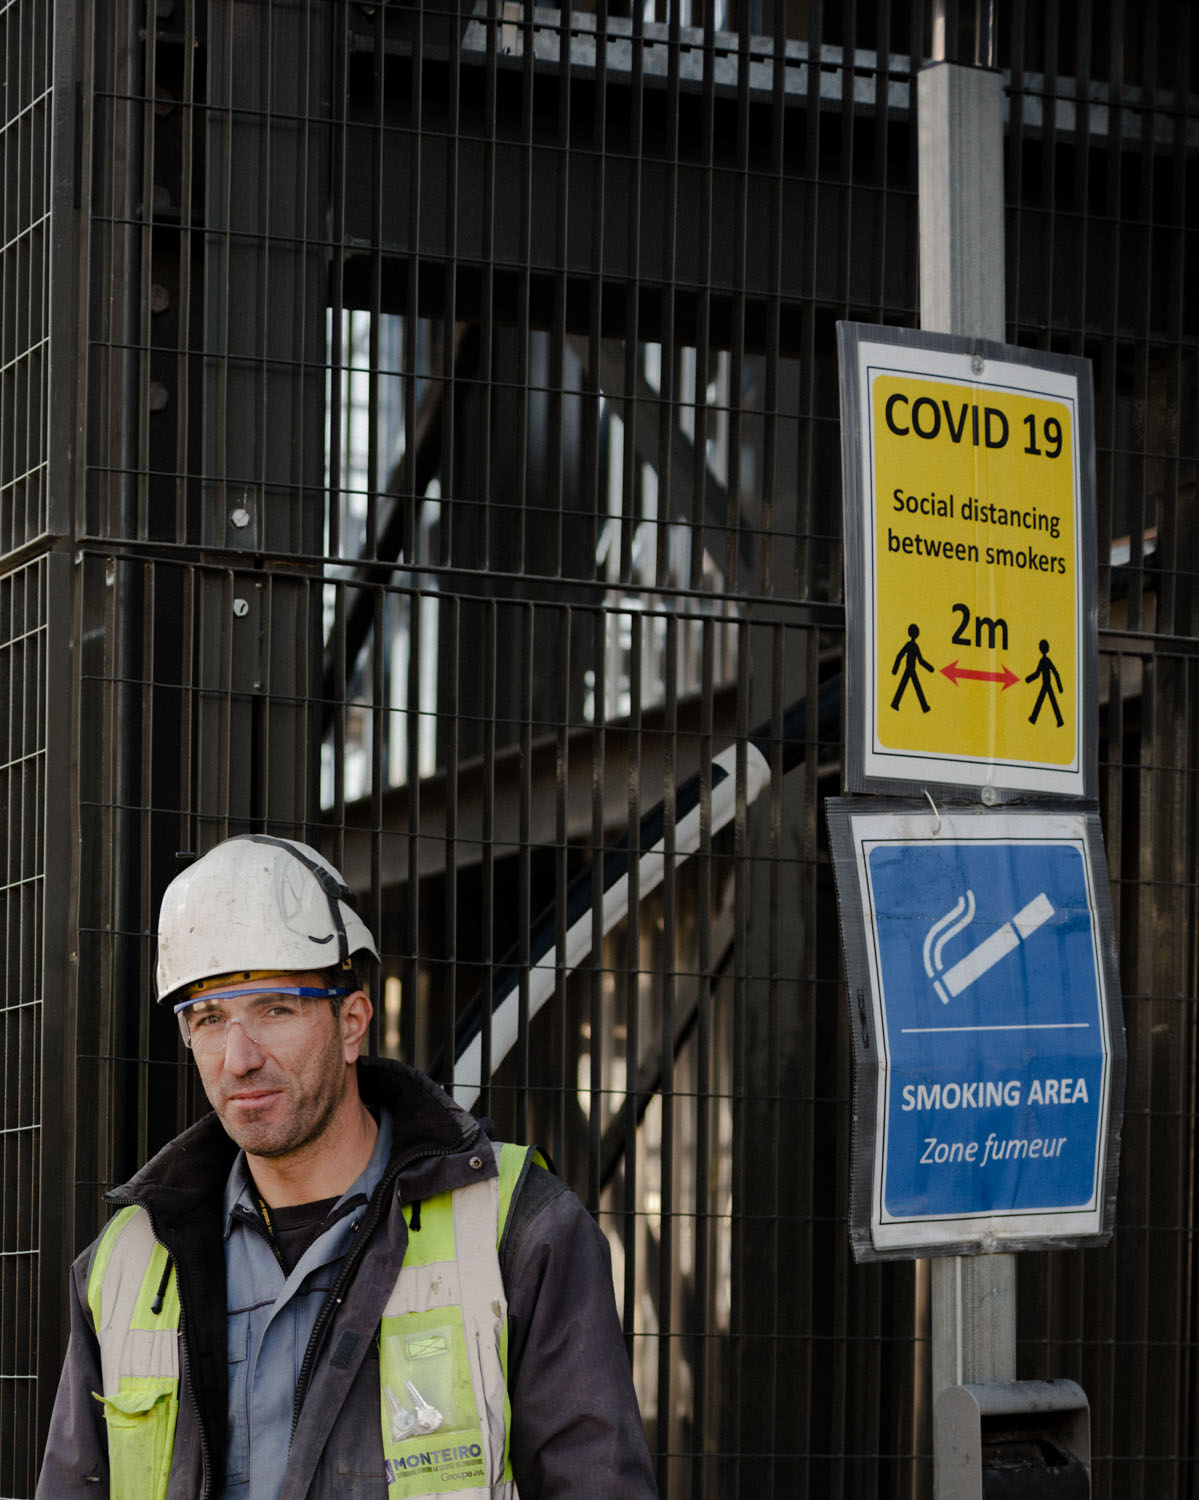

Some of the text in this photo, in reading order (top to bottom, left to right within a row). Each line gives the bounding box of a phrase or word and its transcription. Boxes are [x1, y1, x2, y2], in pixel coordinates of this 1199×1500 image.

[885, 393, 1063, 459] COVID 19
[892, 488, 1061, 539] Social distancing
[887, 528, 1067, 575] between smokers
[951, 602, 1009, 651] 2m
[901, 1078, 1089, 1112] SMOKING AREA
[920, 1133, 1067, 1168] Zone fumeur
[393, 1444, 482, 1470] MONTEIRO
[440, 1471, 473, 1482] Groupe
